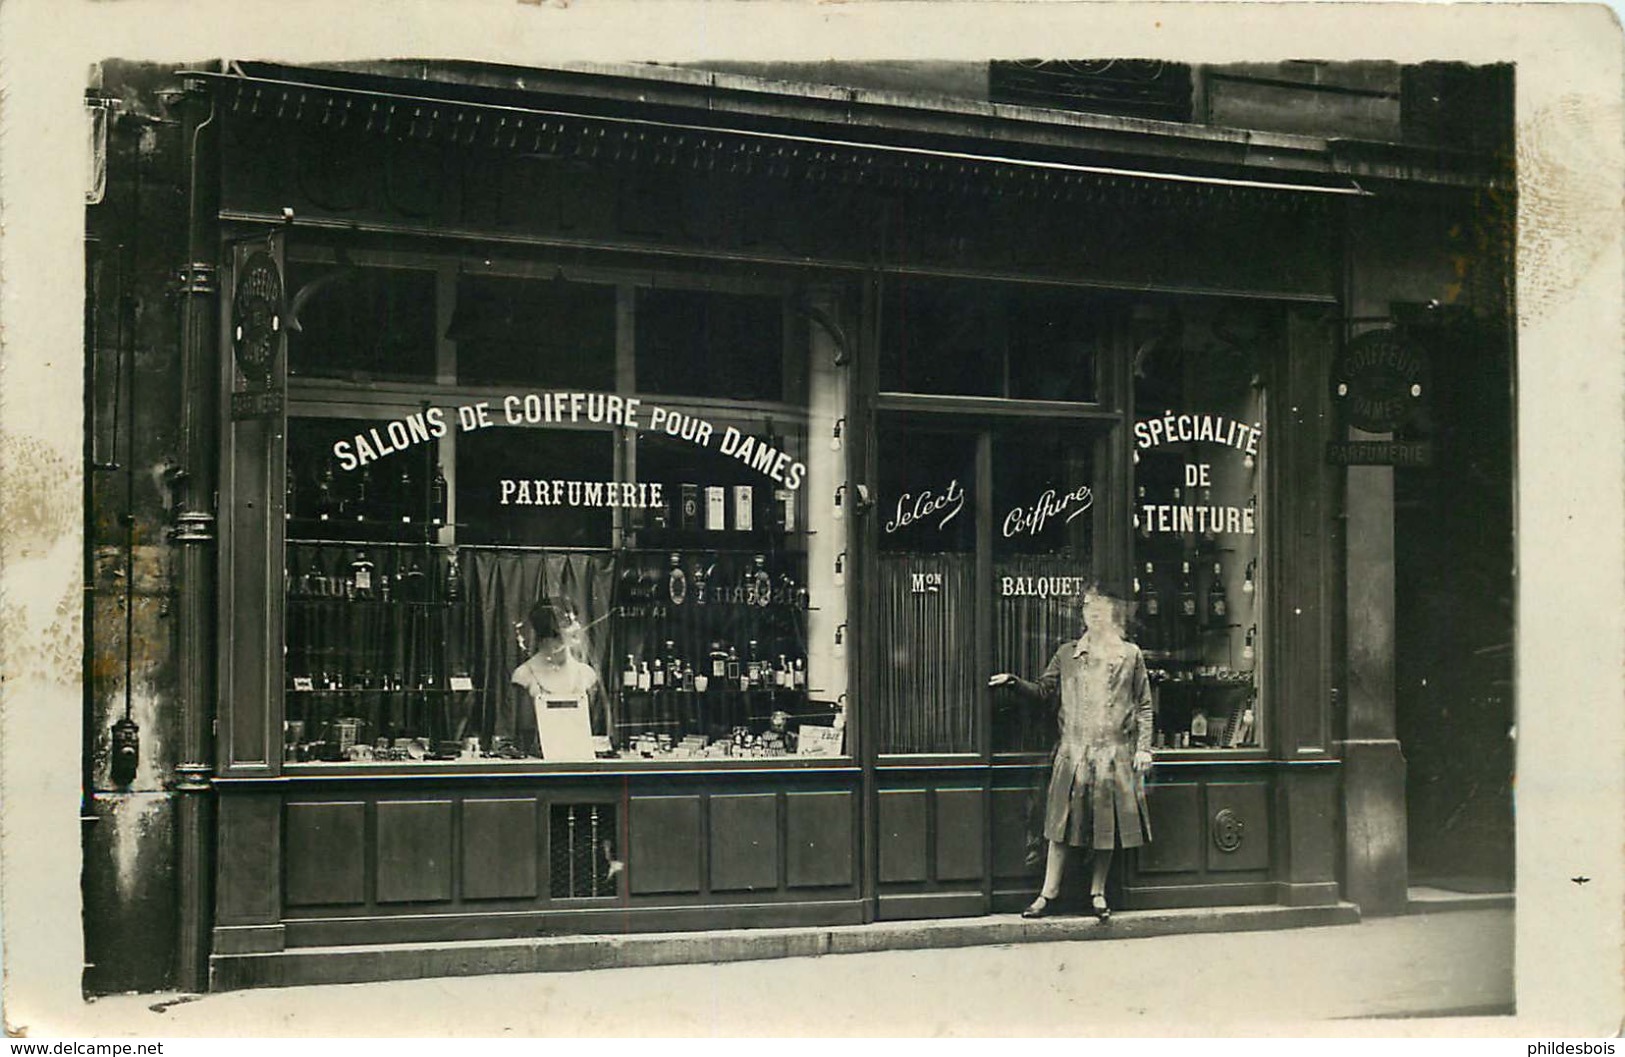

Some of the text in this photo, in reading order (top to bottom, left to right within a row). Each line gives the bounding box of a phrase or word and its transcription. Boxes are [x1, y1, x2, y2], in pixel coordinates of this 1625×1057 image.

[1343, 342, 1421, 381] COIFFEUR
[1353, 396, 1404, 421] DAMES
[333, 392, 807, 490] SALONS DE COIFFURE POUR DAMES
[1133, 409, 1262, 455] SPÉCIALITÉ
[1330, 444, 1425, 463] PARFUMERIE
[1185, 464, 1211, 487] DE
[500, 479, 663, 508] PARFUMERIE
[885, 479, 1094, 538] Select Coiffure
[1143, 505, 1254, 534] TEINTURE
[1002, 576, 1083, 600] BALQUET
